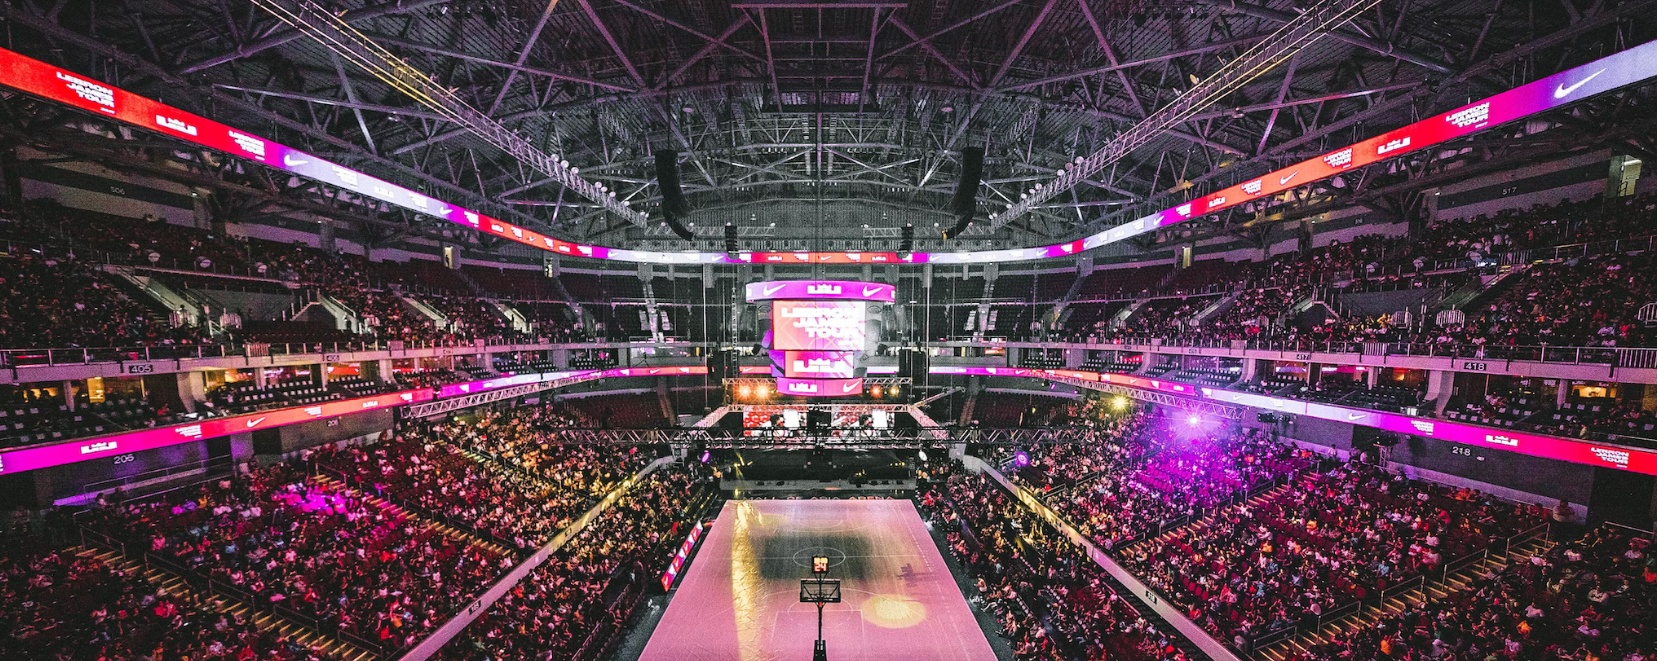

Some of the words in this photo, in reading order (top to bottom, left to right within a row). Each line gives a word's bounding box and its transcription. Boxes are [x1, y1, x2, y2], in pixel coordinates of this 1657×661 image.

[76, 89, 115, 108] TOUR
[1445, 102, 1489, 121] LEBRON
[1451, 107, 1489, 125] JAMES
[1457, 113, 1488, 128] TOUR
[1332, 157, 1352, 167] TOUR
[1502, 186, 1517, 195] 517
[781, 307, 858, 317] LEBRON
[805, 328, 858, 337] TOUR
[131, 364, 152, 373] 405
[1465, 362, 1485, 371] 418
[1452, 446, 1471, 456] 218
[1591, 447, 1629, 457] LEBRON
[114, 453, 135, 465] 205
[1601, 457, 1628, 465] TOUR
[814, 563, 827, 571] 24
